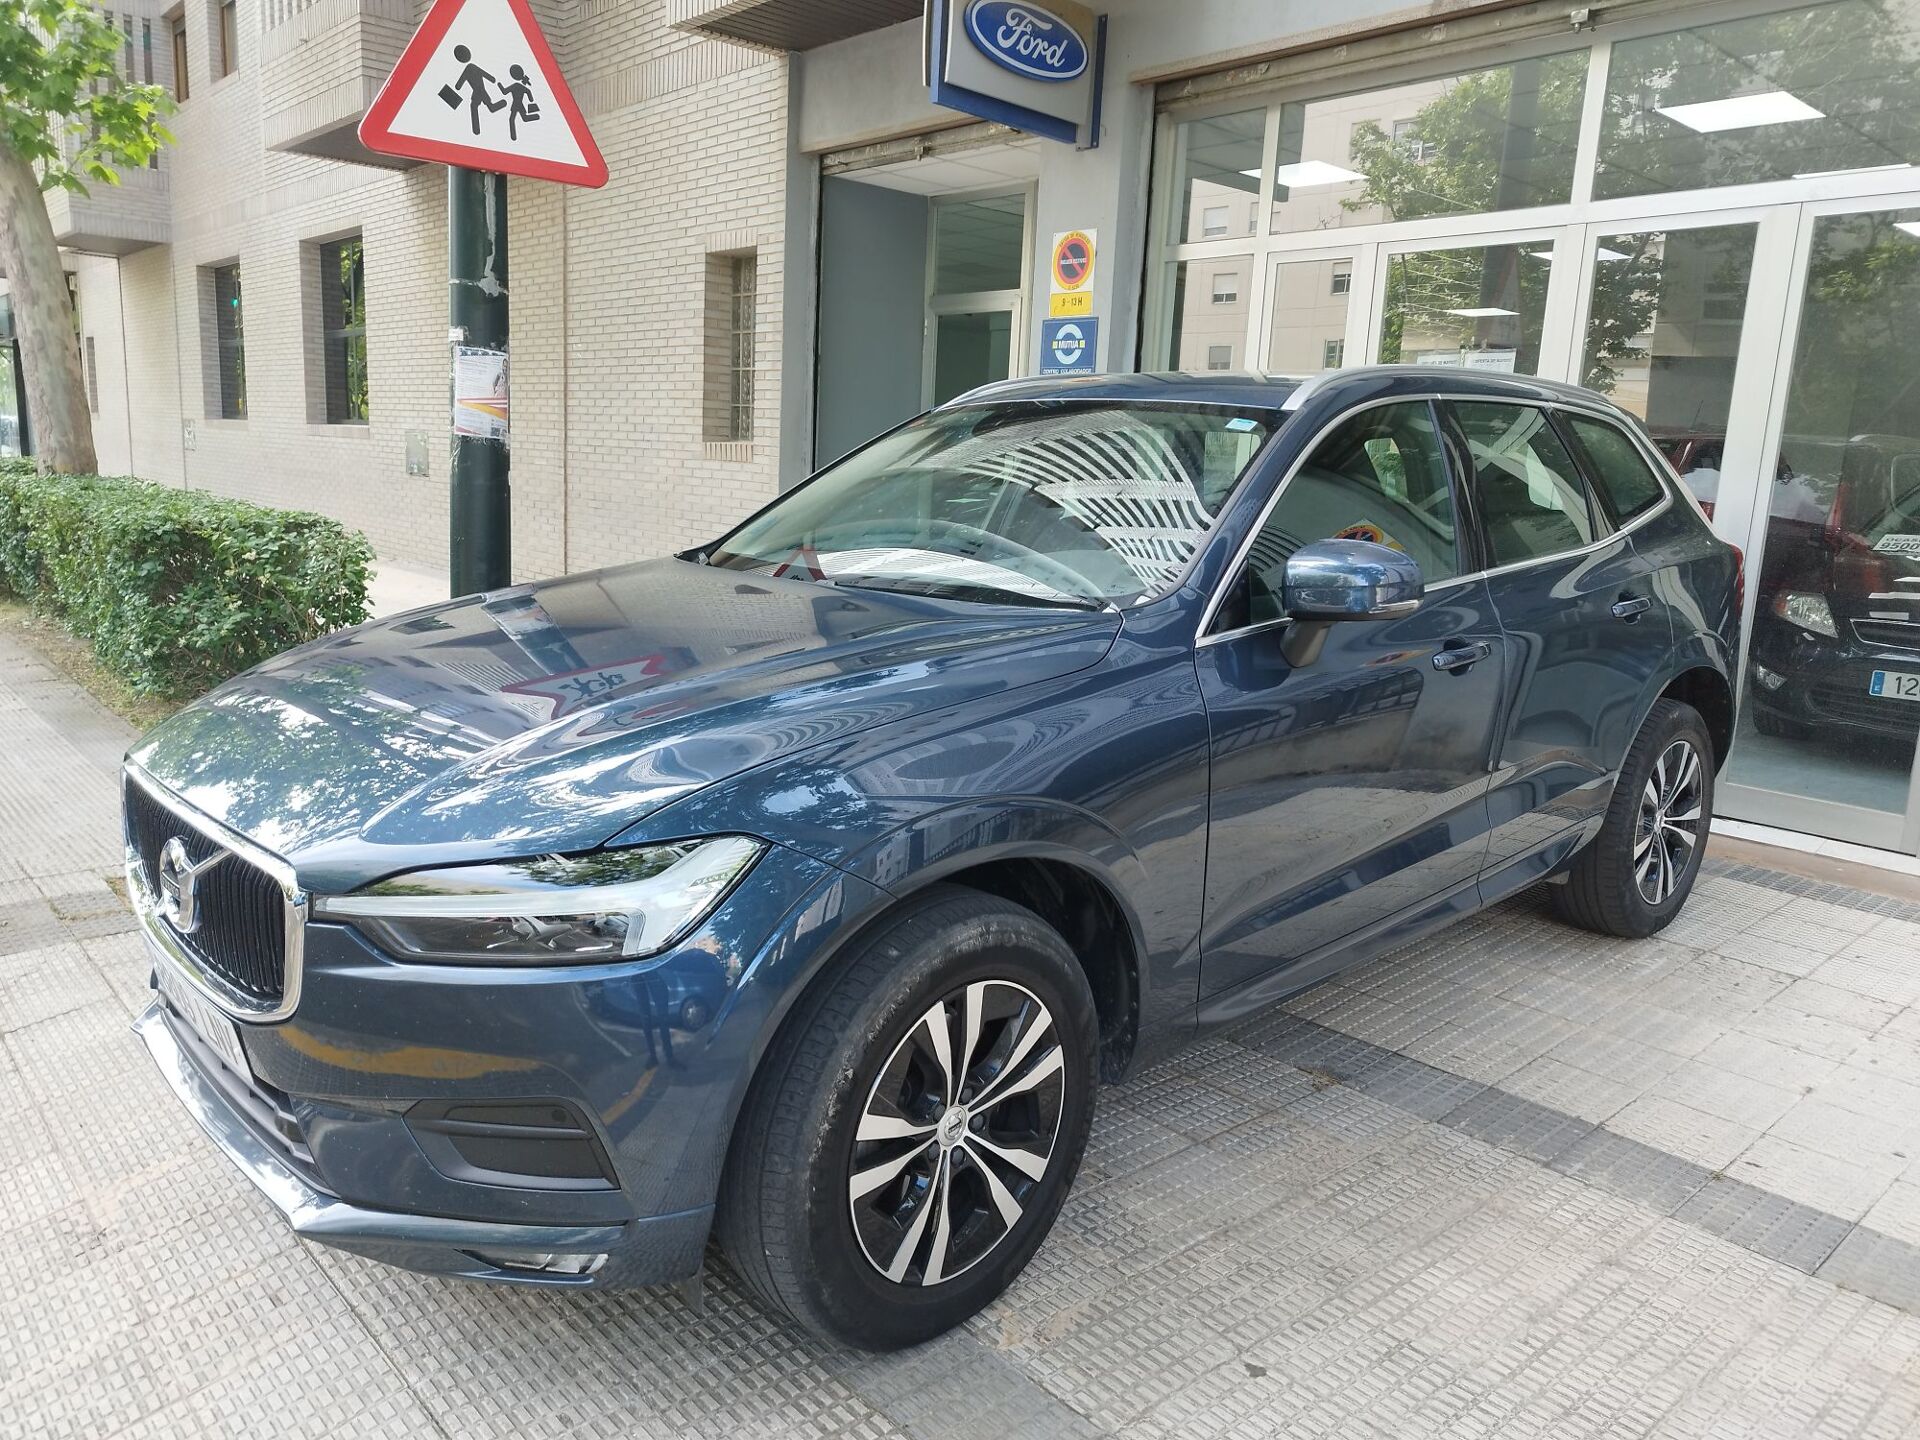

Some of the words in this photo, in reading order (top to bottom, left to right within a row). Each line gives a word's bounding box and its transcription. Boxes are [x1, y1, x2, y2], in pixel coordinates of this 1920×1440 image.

[997, 8, 1068, 67] Ford
[1058, 340, 1078, 349] MUTUA
[1895, 675, 1920, 697] 12
